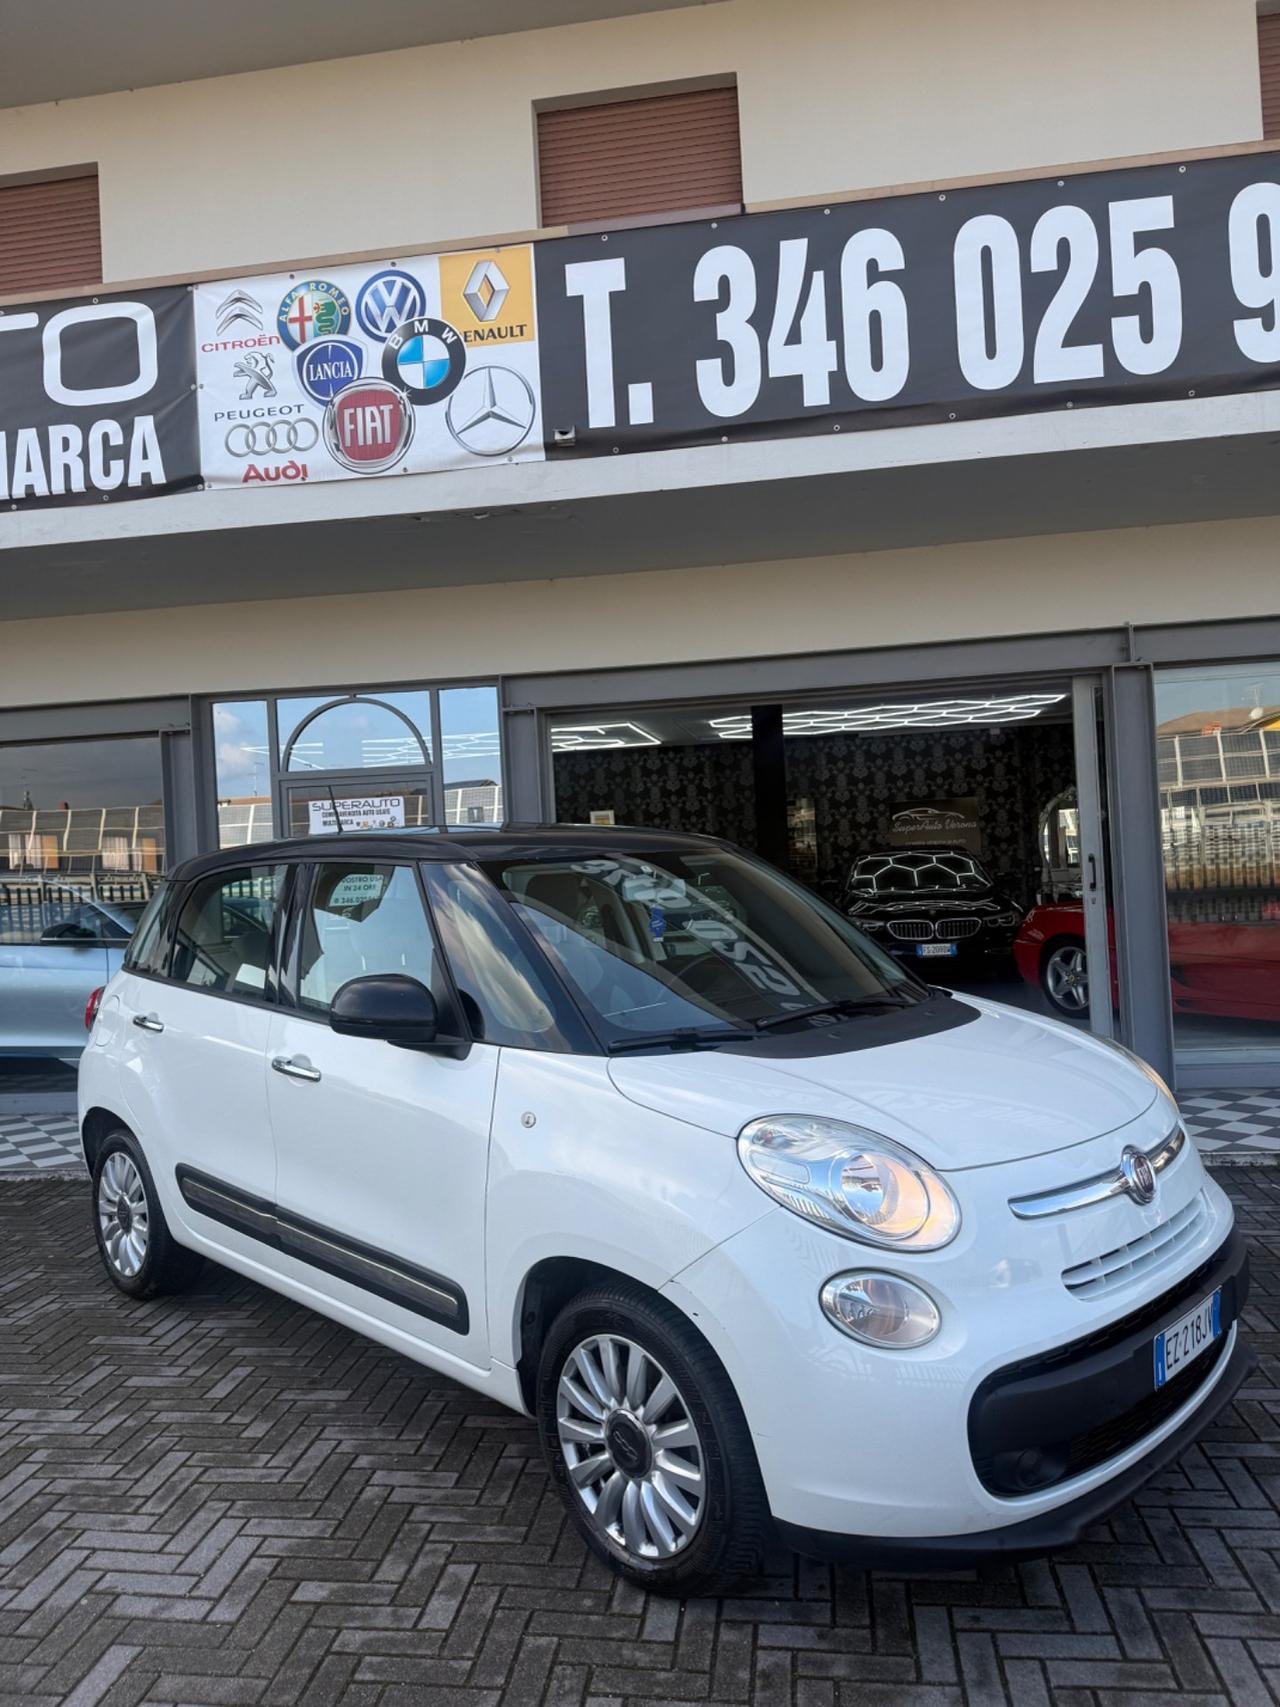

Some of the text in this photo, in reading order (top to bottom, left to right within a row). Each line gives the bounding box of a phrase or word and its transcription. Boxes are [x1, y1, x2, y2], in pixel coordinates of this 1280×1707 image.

[279, 282, 350, 322] ALFA ROMEO
[565, 257, 654, 429] T.
[693, 228, 910, 418] 346
[952, 195, 1183, 391] 025
[388, 319, 458, 350] BMW
[461, 323, 528, 344] ENAULT
[309, 361, 353, 382] LANCIA
[214, 403, 305, 423] PEUGEOT
[343, 403, 394, 448] FIAT
[0, 415, 167, 499] ARCA
[242, 460, 309, 483] Audi
[311, 798, 401, 812] SUPERAUTO
